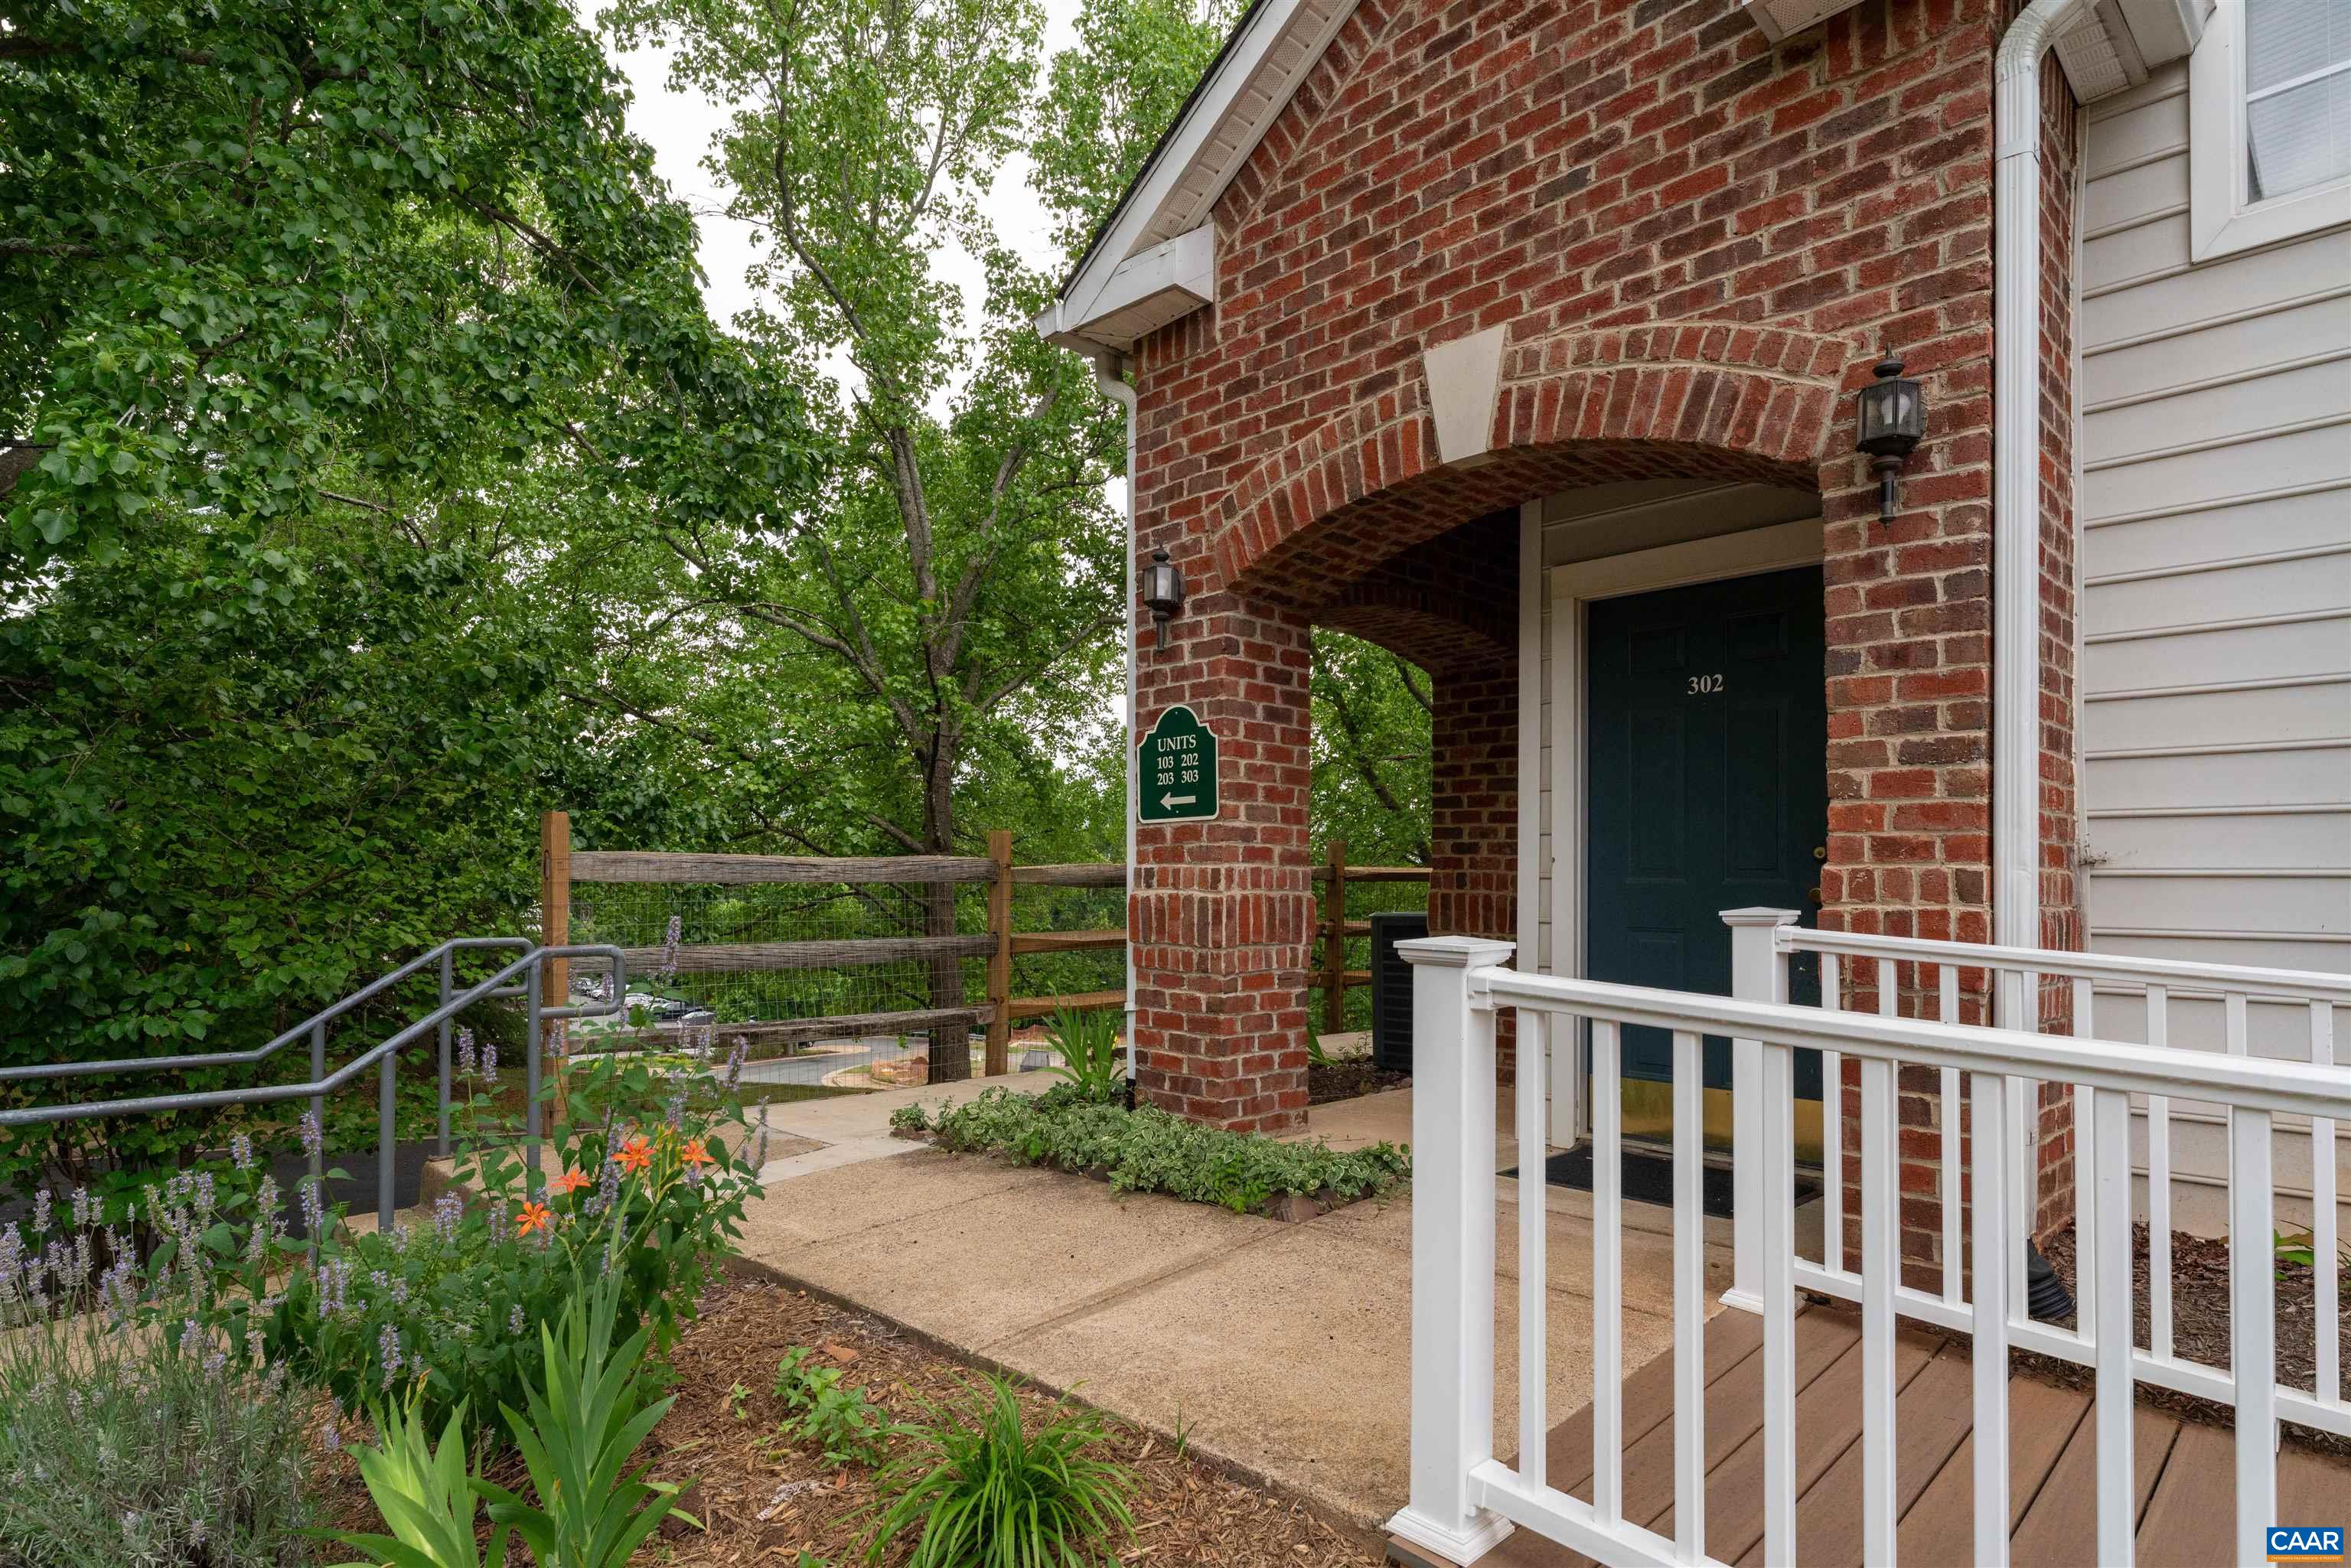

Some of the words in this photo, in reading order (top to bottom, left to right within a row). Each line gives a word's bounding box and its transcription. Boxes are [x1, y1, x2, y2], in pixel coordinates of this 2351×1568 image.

[1687, 673, 1723, 695] 302
[1157, 734, 1197, 752] UNITS
[1156, 755, 1174, 770] 103
[1181, 753, 1199, 767] 202
[1156, 772, 1175, 786] 203
[1181, 769, 1199, 784] 303
